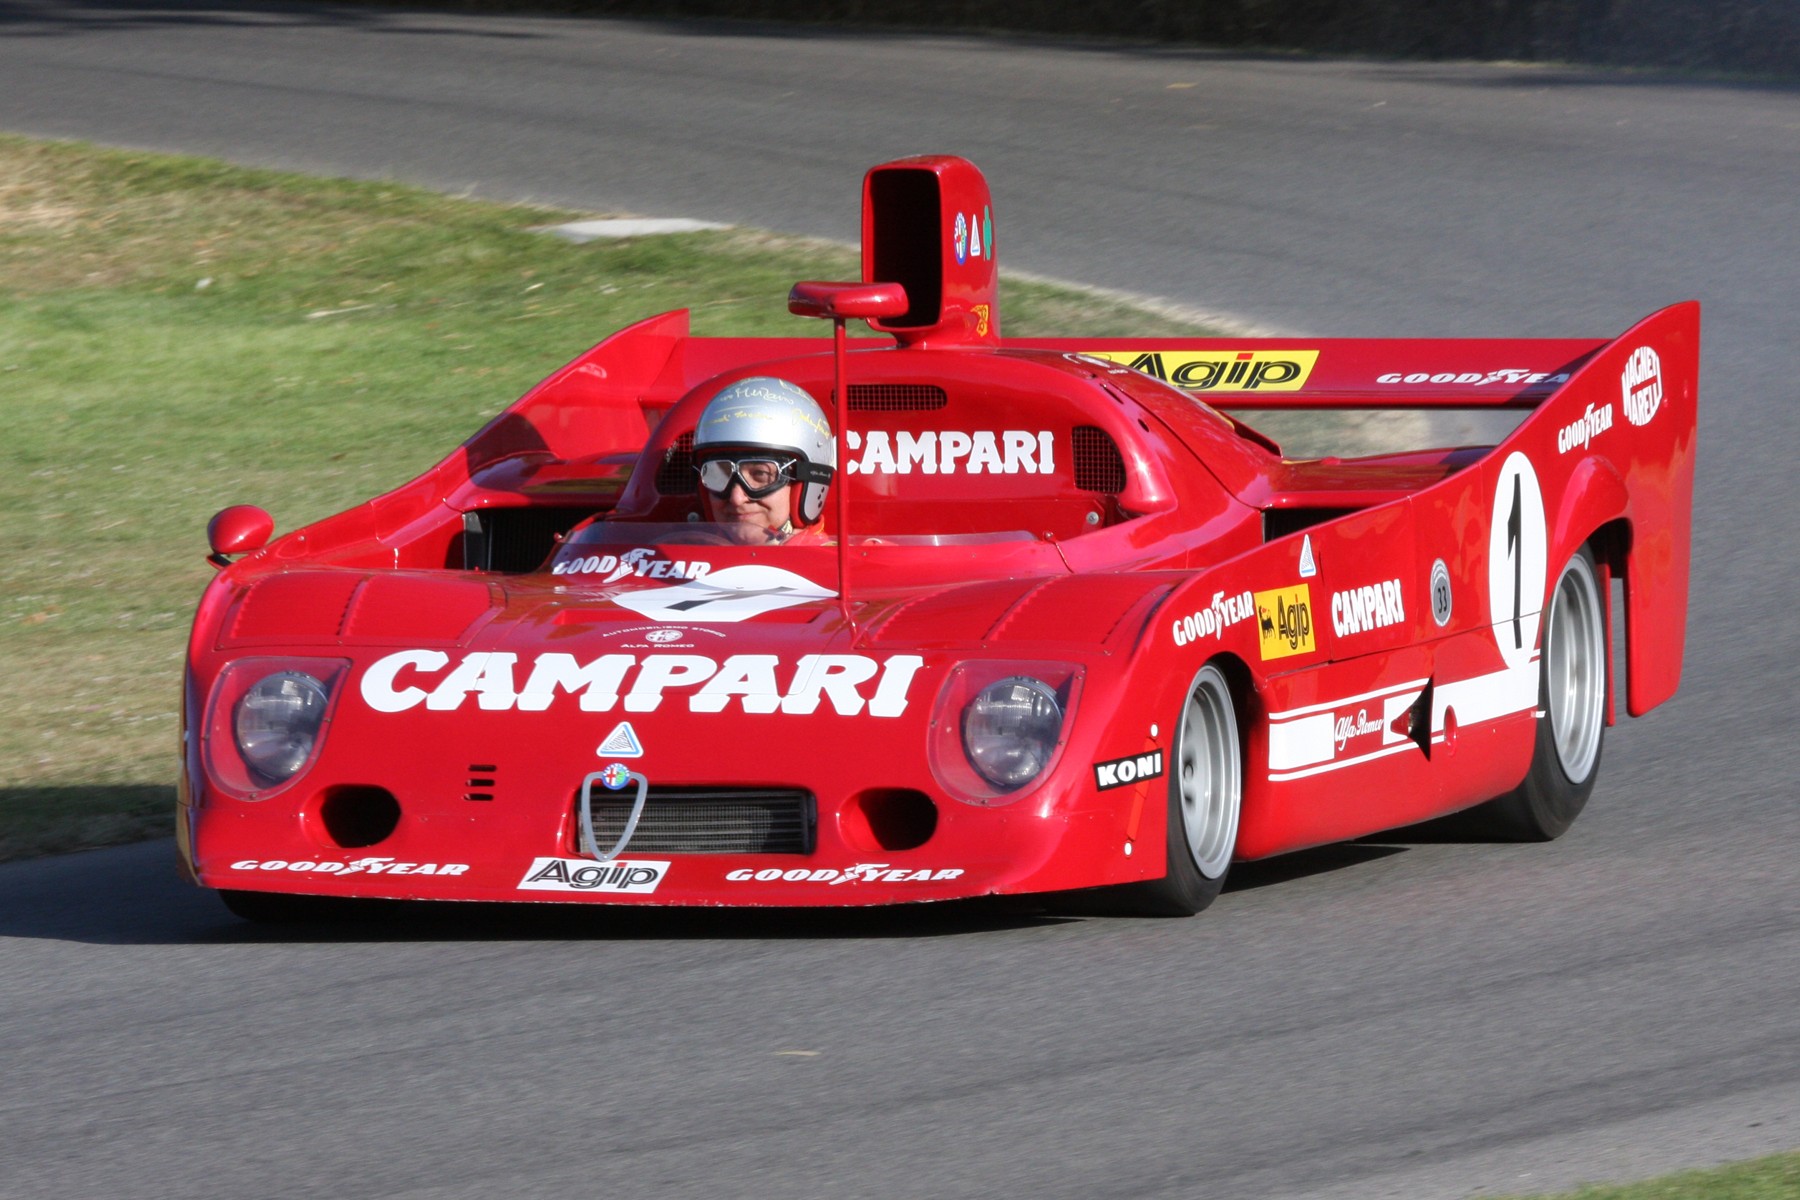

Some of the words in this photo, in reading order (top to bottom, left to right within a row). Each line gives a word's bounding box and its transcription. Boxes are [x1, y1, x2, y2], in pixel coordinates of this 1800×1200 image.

[1126, 352, 1302, 390] Agip
[1375, 370, 1571, 385] GOODYEA
[1506, 472, 1523, 650] 1
[1331, 578, 1406, 638] CAMPARI
[1437, 585, 1448, 614] 33
[1172, 591, 1255, 646] GOODYEAR
[1277, 594, 1311, 650] Agip
[360, 648, 924, 718] CAMPARI
[1097, 753, 1162, 787] KONI
[230, 858, 470, 876] GOODYEAR
[526, 859, 659, 890] Agip
[725, 865, 965, 884] GOODYEAR
